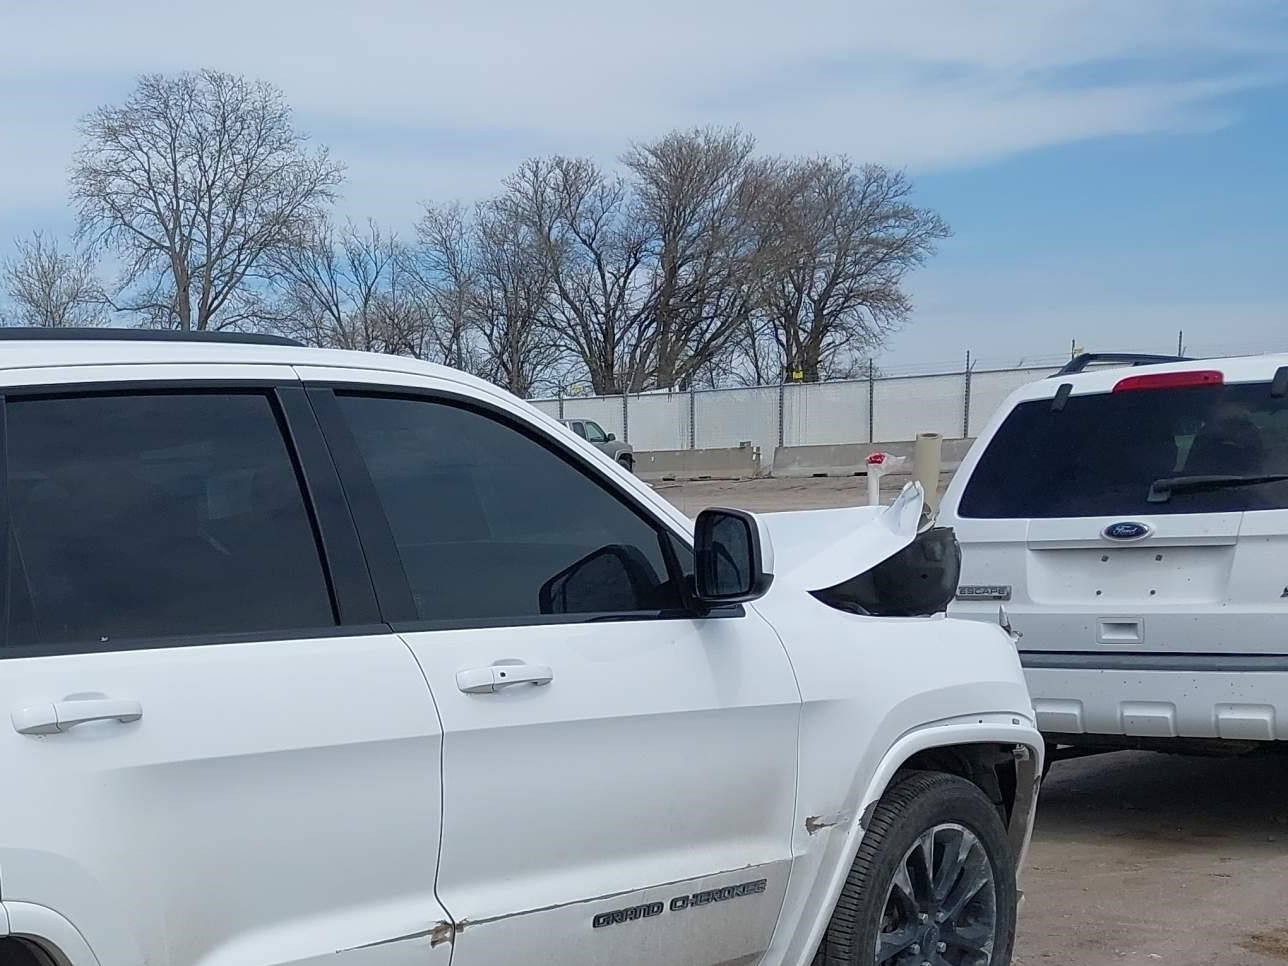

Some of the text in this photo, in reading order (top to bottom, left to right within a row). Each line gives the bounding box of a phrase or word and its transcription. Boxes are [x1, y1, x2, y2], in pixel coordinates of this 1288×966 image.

[958, 585, 1009, 596] ESCAPE
[592, 878, 768, 929] GRAND CHEROKEE
